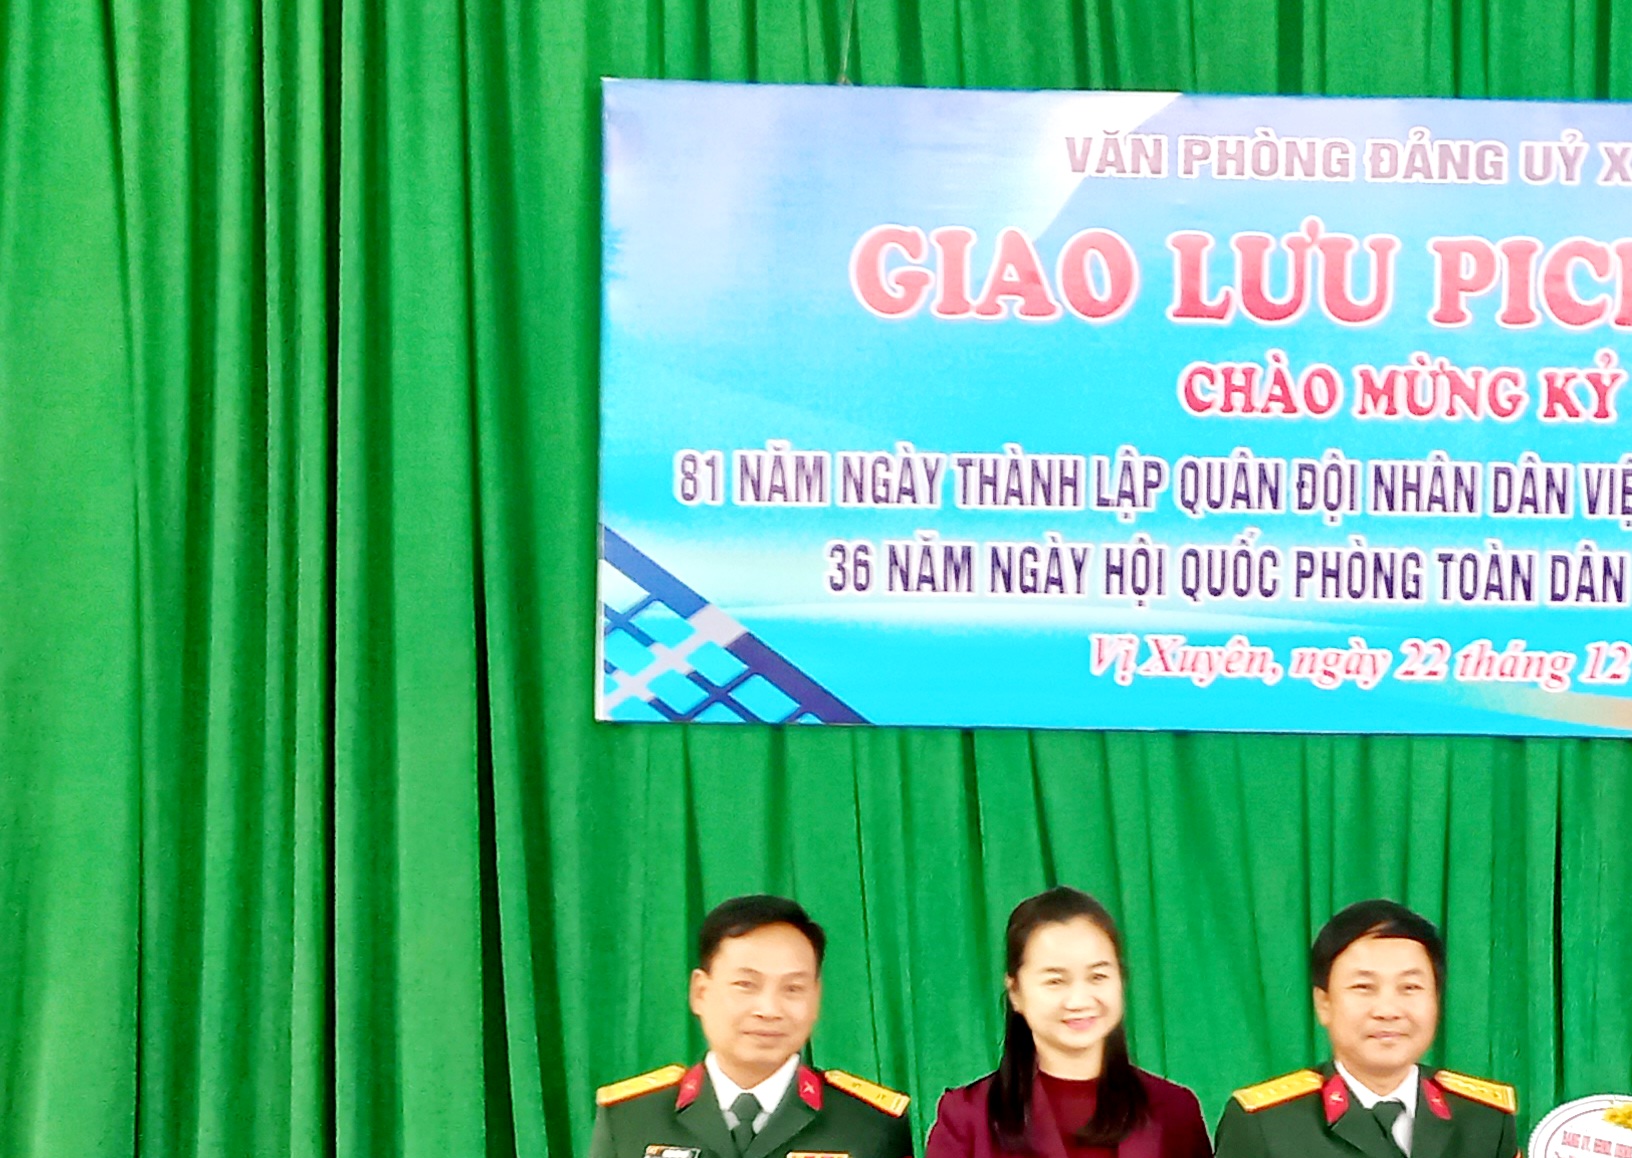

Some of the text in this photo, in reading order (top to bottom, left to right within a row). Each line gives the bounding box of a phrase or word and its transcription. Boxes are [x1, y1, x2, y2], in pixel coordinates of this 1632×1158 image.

[1065, 130, 1165, 176] VĂN
[1182, 130, 1351, 178] PHÒNG
[1369, 130, 1505, 180] ĐẢNG
[1523, 133, 1587, 181] UỶ
[855, 228, 1135, 318] GIAO
[1169, 218, 1397, 323] LƯU
[1183, 352, 1339, 416] CHÀO
[1358, 356, 1523, 418] MỪNG
[1543, 352, 1622, 419] KỶ
[680, 453, 719, 502] 81
[738, 445, 826, 503] NĂM
[842, 447, 942, 504] NGÀY
[956, 448, 1080, 507] THÀNH
[1096, 448, 1163, 519] LẬP
[1180, 451, 1282, 513] QUÂN
[1296, 452, 1359, 522] ĐỘI
[1373, 454, 1477, 514] NHÂN
[1492, 455, 1568, 515] DÂN
[828, 543, 871, 591] 36
[888, 534, 973, 592] NĂM
[990, 536, 1090, 595] NGÀY
[1105, 536, 1166, 607] HỘI
[1181, 530, 1280, 602] QUỐC
[1295, 538, 1420, 601] PHÒNG
[1437, 542, 1534, 602] TOÀN
[1550, 543, 1625, 602] DÂN
[1092, 636, 1132, 682] Vị
[1139, 636, 1280, 684] Xuyên,
[1294, 640, 1388, 687] ngày
[1397, 642, 1449, 678] 22
[1458, 642, 1571, 688] tháng
[1581, 645, 1631, 681] 12
